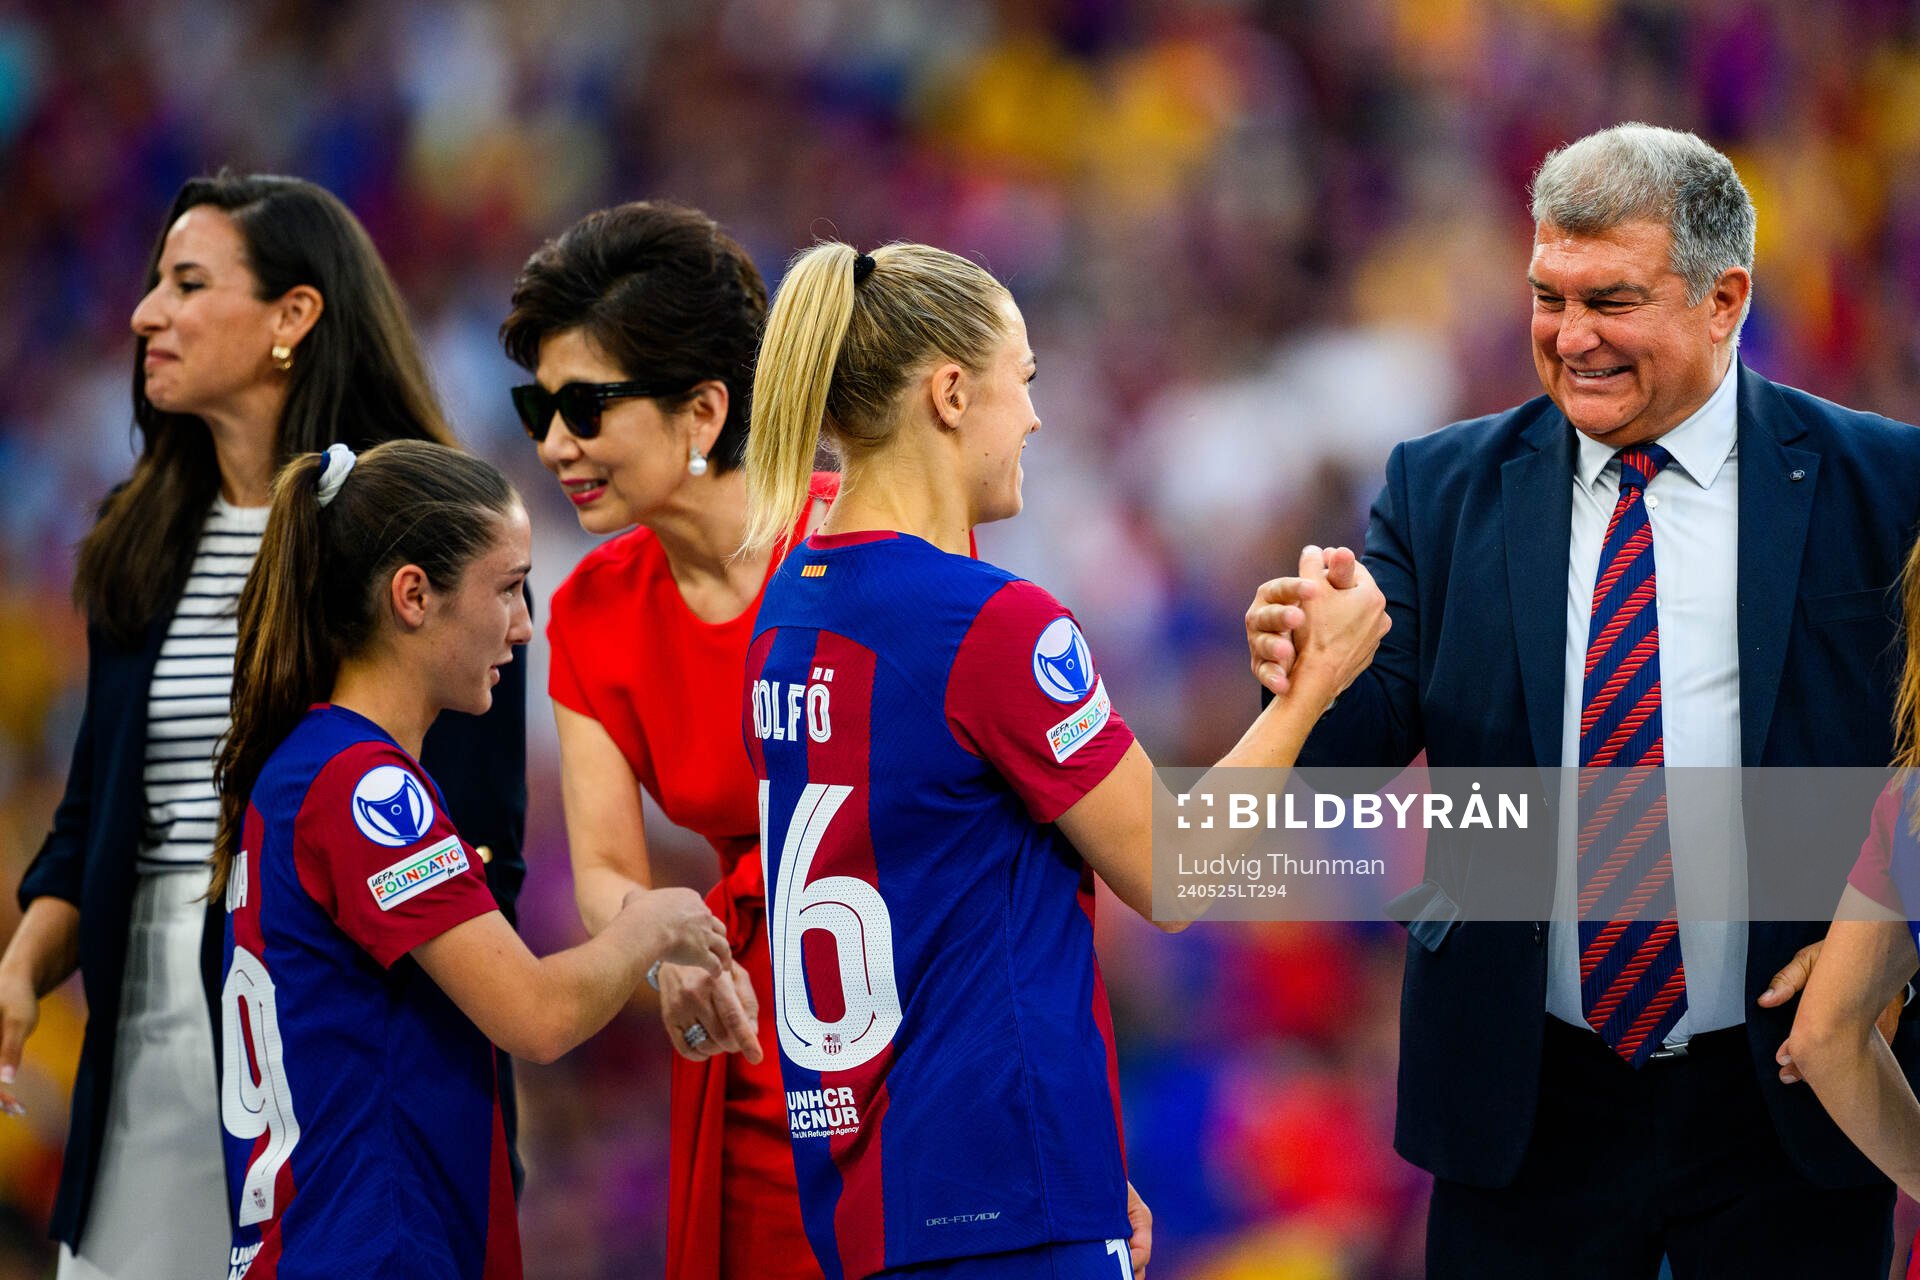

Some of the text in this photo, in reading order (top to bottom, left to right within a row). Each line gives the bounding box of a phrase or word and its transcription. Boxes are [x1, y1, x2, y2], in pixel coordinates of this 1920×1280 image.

[1050, 722, 1069, 739] UEFA
[371, 871, 394, 887] UEFA
[786, 1087, 856, 1110] UNHCR
[790, 1106, 860, 1130] ACNUR
[808, 1129, 834, 1138] Refugee
[835, 1126, 859, 1136] Agency
